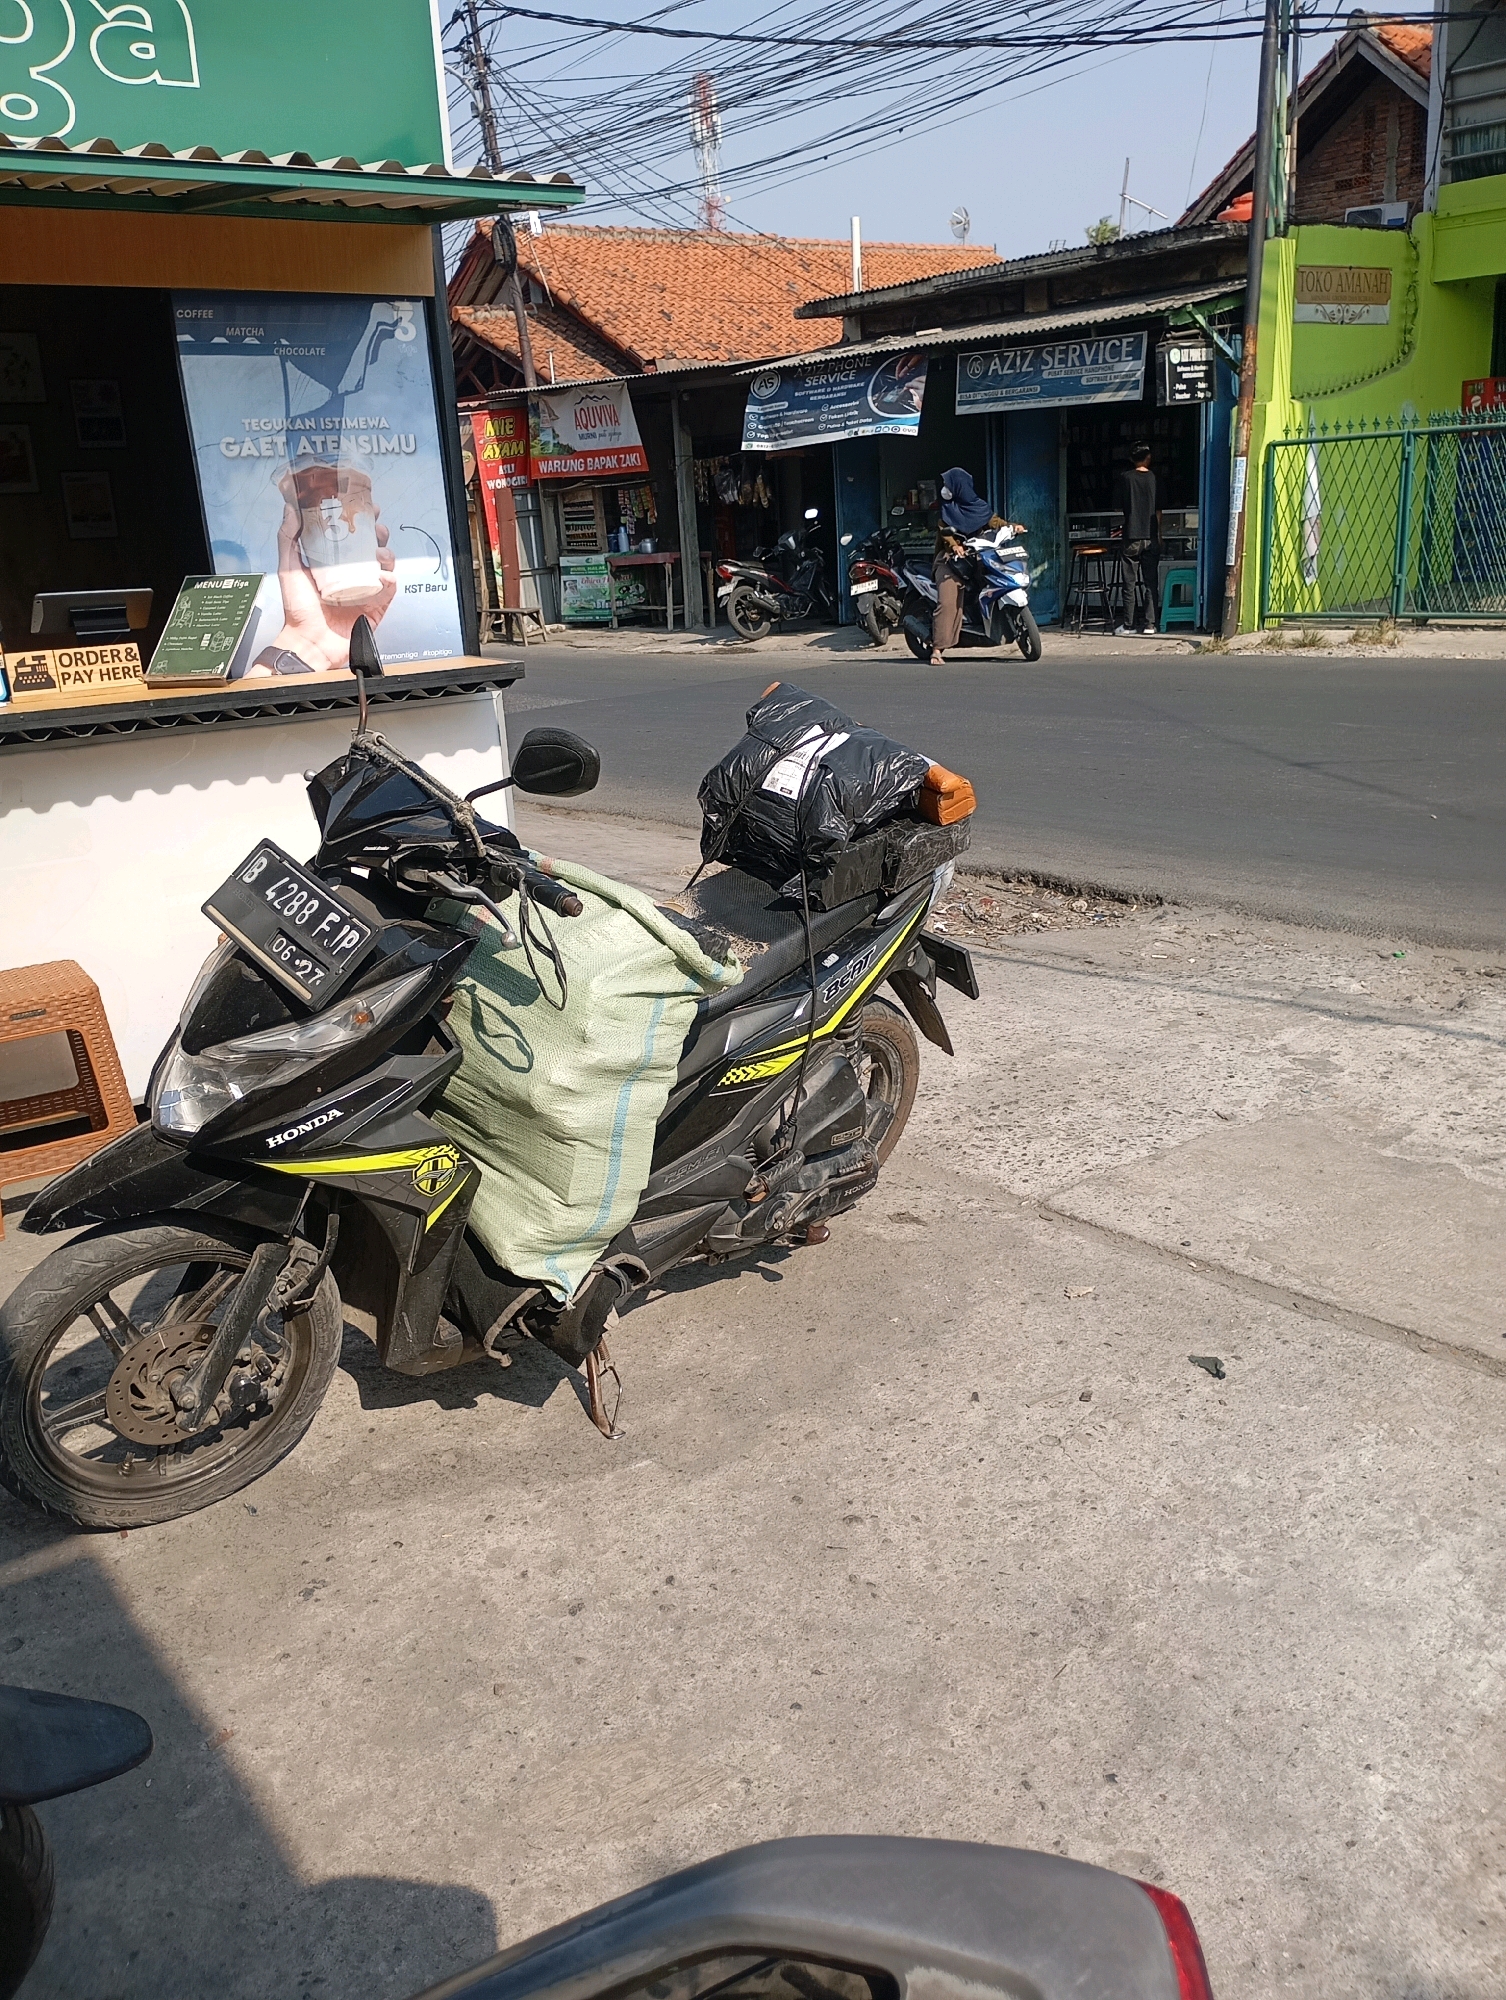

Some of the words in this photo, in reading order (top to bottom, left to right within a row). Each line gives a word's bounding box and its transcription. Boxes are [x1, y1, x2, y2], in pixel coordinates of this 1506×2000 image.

[1300, 271, 1333, 293] TOKO
[1336, 272, 1389, 294] AMANAH
[176, 309, 214, 319] COFFEE
[225, 327, 265, 337] MATCHA
[273, 346, 326, 356] CHOCOLATE
[987, 349, 1035, 376] AZIZ
[1041, 337, 1134, 370] SERVICE
[827, 356, 872, 373] PHONE
[804, 369, 857, 388] SERVICE
[241, 417, 317, 432] TEGUKAN
[319, 416, 390, 430] ISTIMEWA
[484, 416, 515, 439] MIE
[574, 403, 621, 432] AQUVIVA
[219, 436, 288, 459] GAET
[296, 433, 417, 455] ATENSIMU
[481, 439, 526, 461] AYAM
[498, 463, 515, 475] ASLI
[538, 458, 586, 474] WARUNG
[587, 455, 619, 471] BAPAK
[620, 453, 642, 467] ZAKI
[194, 580, 223, 589] MENU
[404, 584, 424, 594] KST
[425, 583, 448, 593] Baru
[58, 648, 121, 668] ORDER
[124, 647, 139, 662] &
[61, 669, 94, 685] PAY
[99, 664, 141, 682] HERE
[242, 856, 268, 884] B
[265, 876, 320, 925] 4288
[311, 911, 360, 956] FJP
[266, 1108, 344, 1149] HONDA
